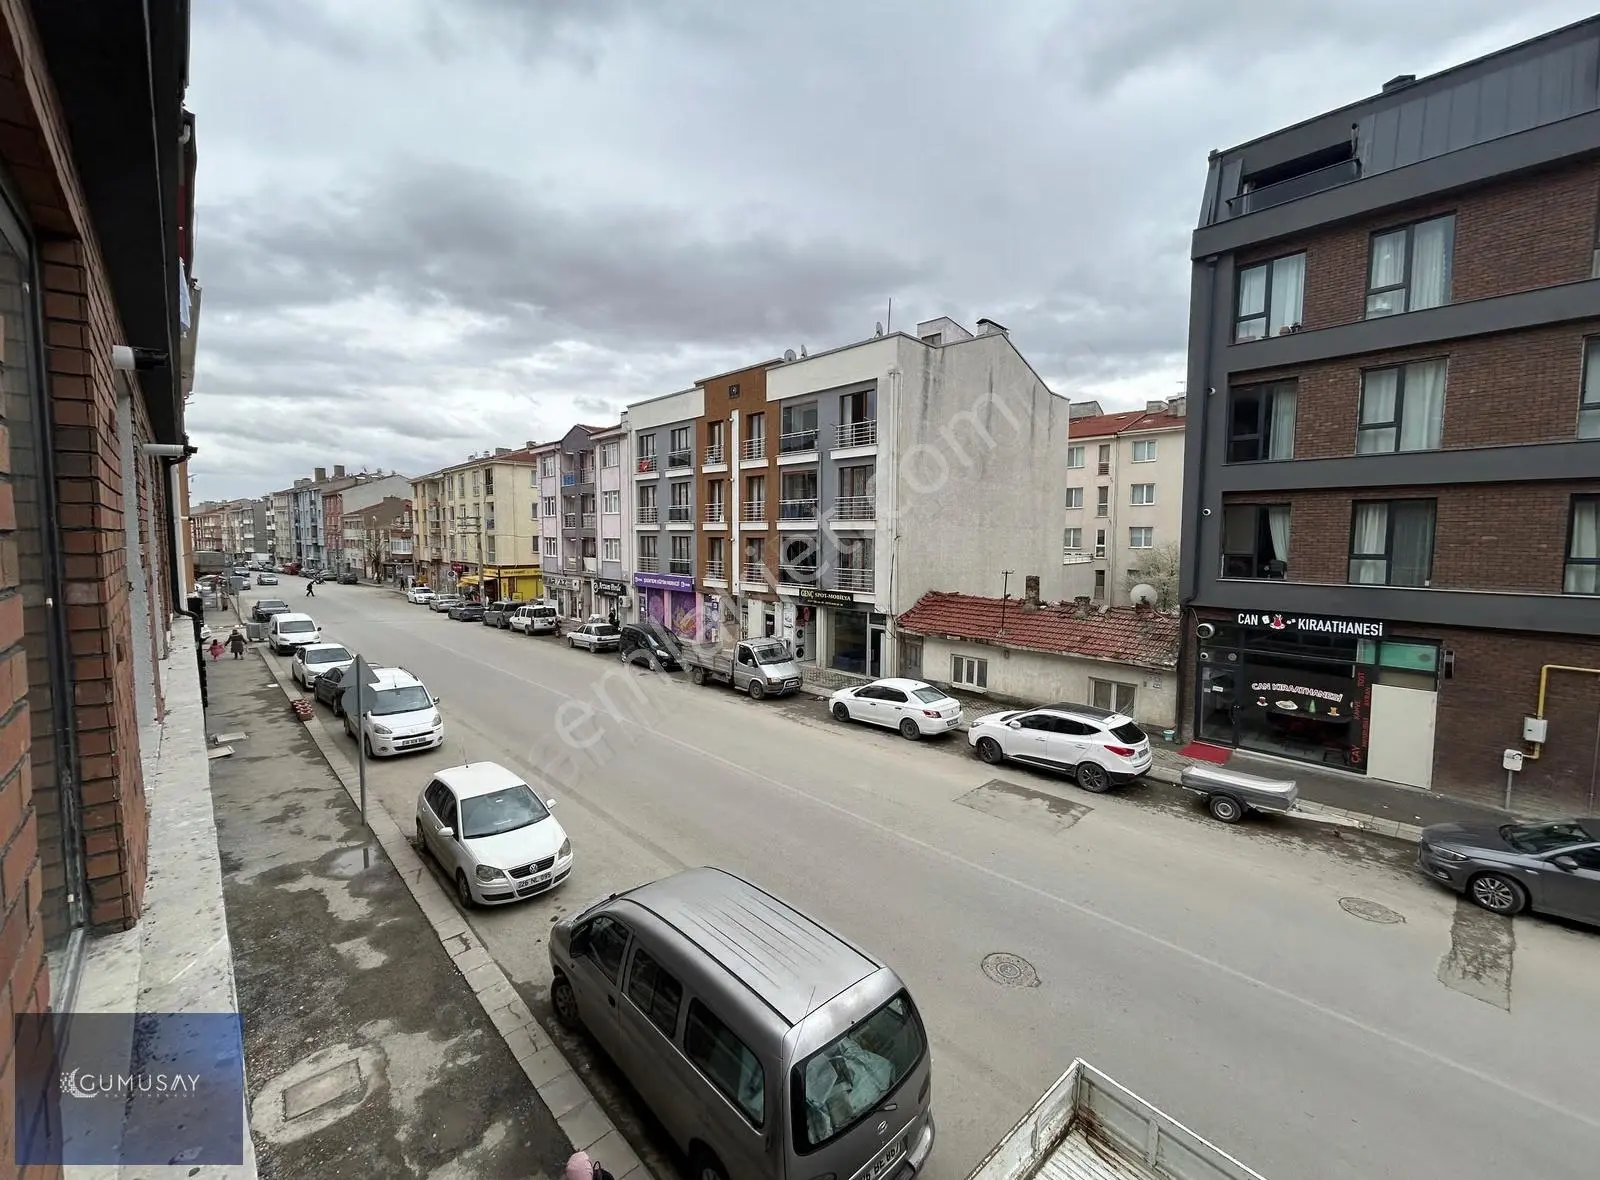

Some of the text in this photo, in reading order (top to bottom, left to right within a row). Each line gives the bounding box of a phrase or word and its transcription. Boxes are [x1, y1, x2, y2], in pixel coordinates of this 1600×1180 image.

[801, 590, 814, 599] GENÇ
[1238, 613, 1383, 637] CAN KIRAATHANESİ
[1251, 682, 1271, 691] CAN
[1351, 745, 1361, 763] ÇAY
